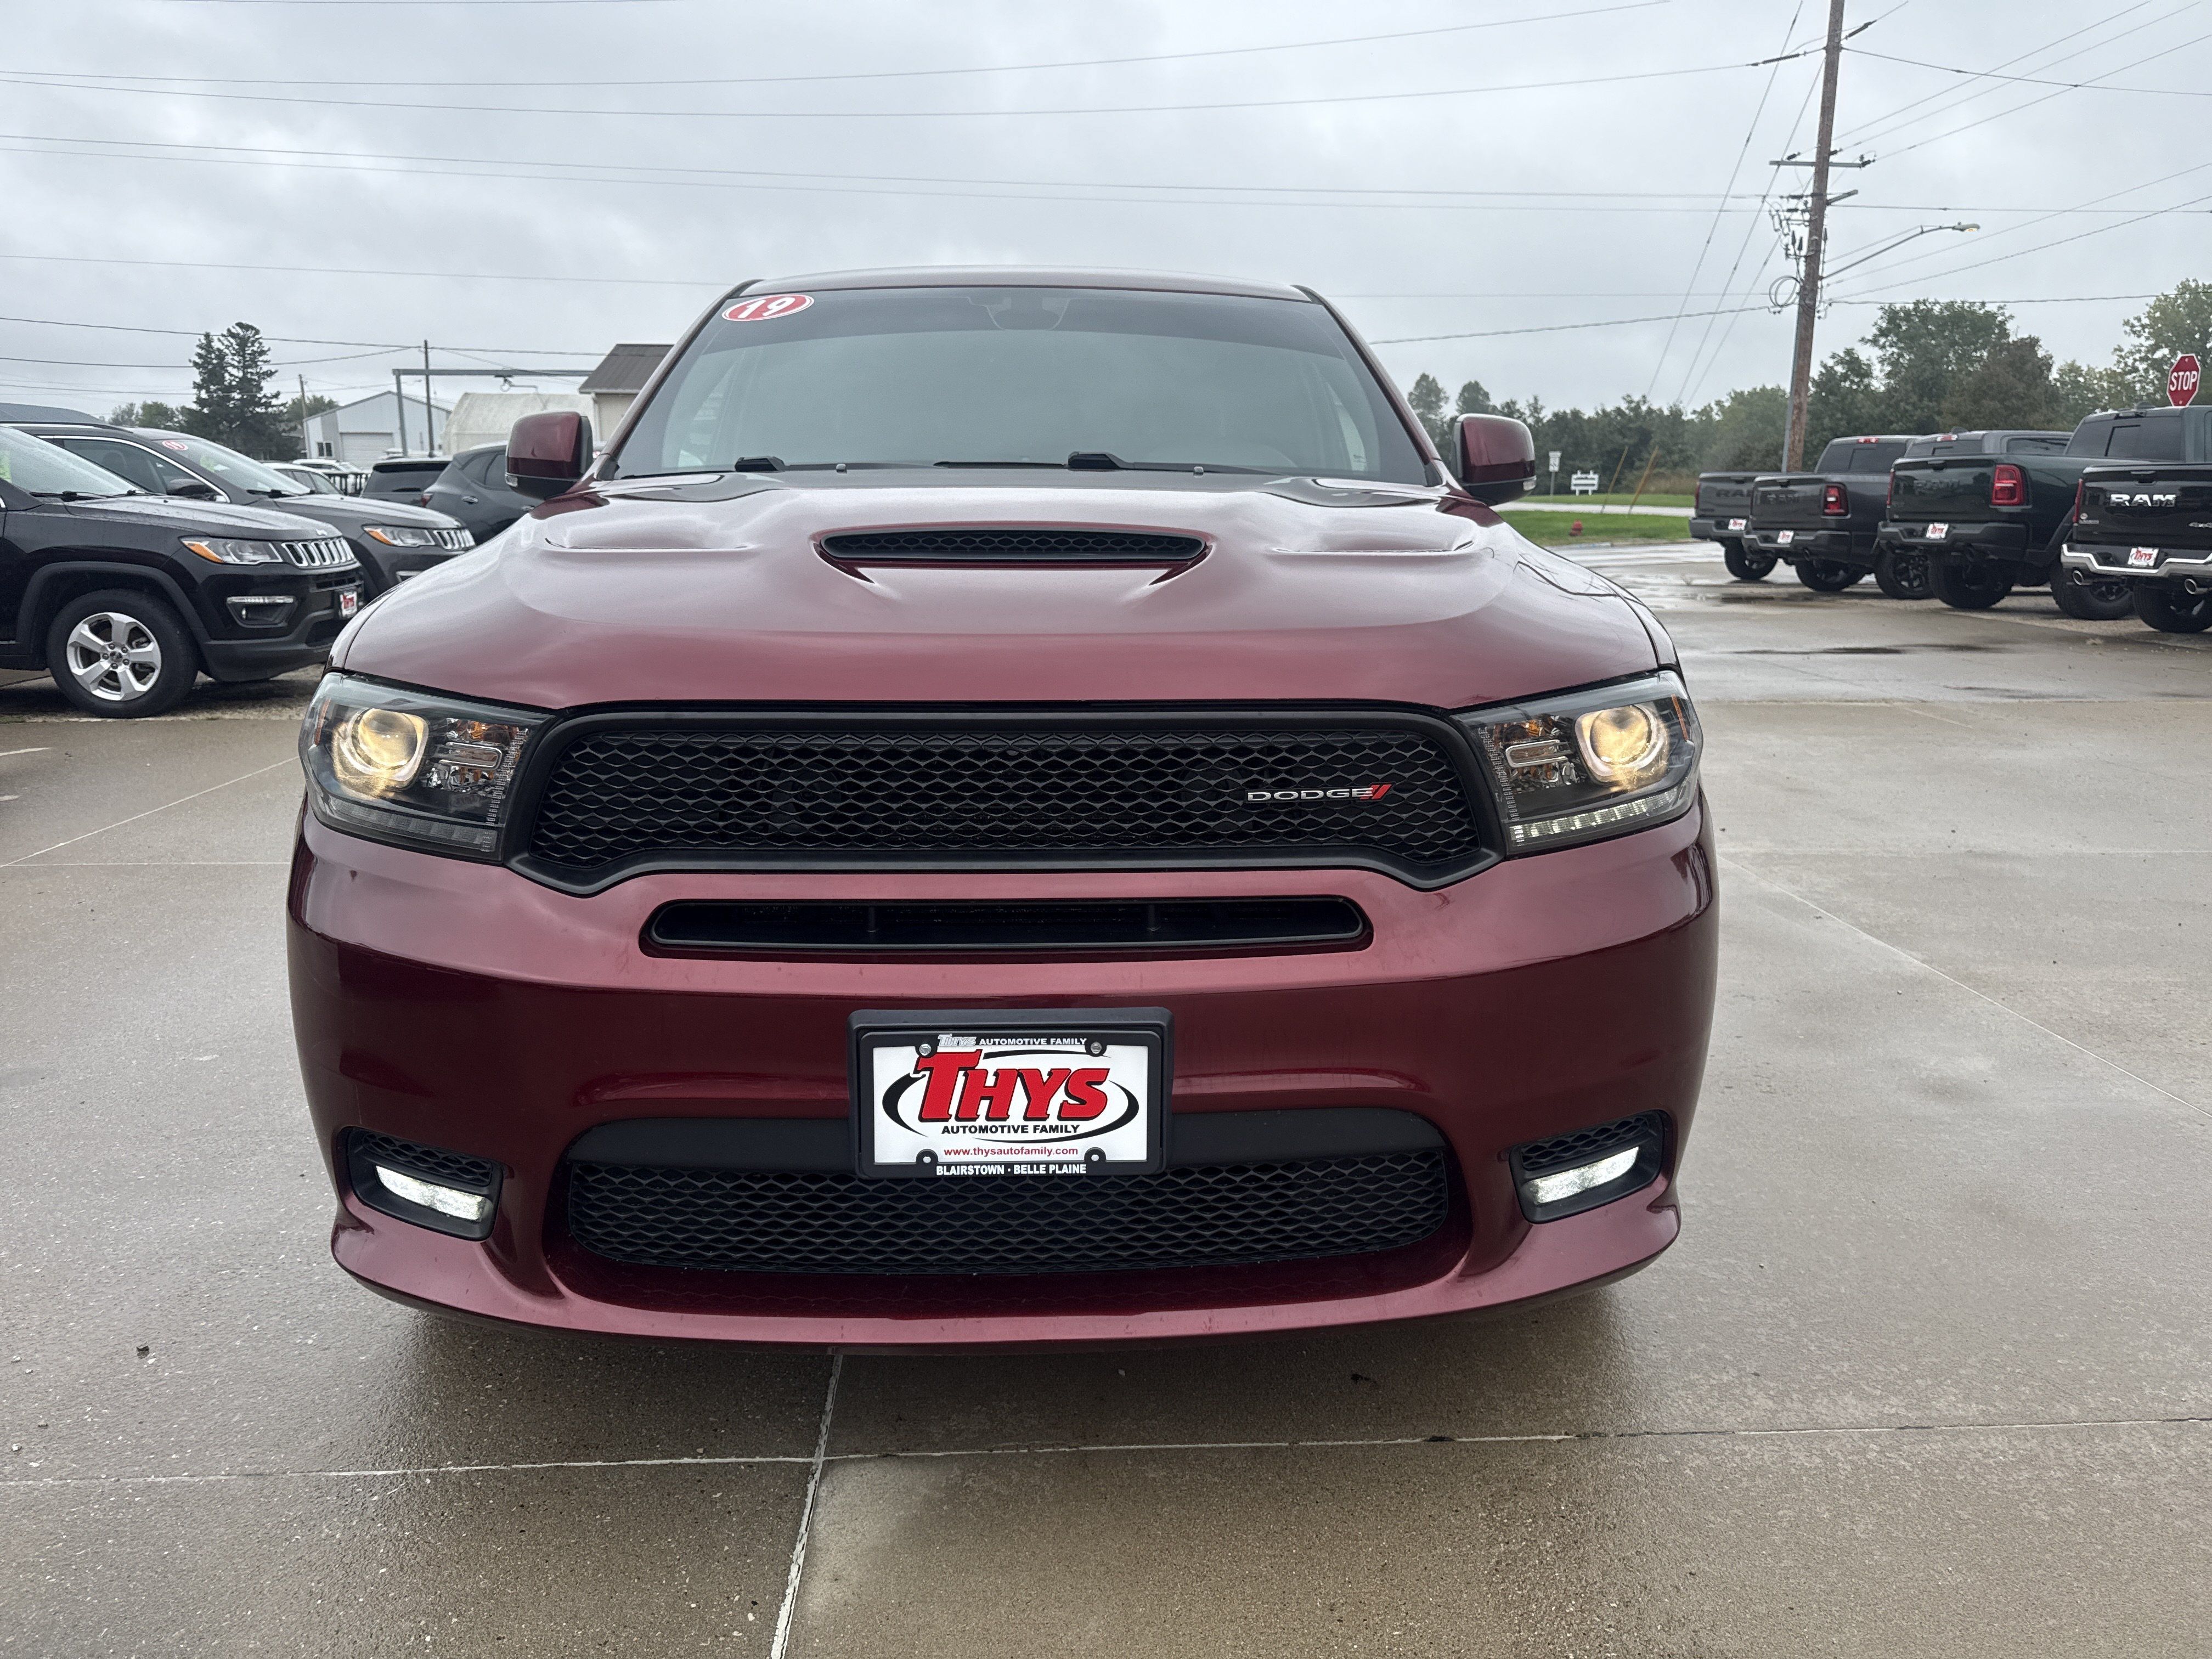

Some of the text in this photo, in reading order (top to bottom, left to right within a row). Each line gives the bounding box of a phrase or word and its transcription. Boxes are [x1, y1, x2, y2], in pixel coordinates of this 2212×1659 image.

[737, 297, 795, 319] 19
[2170, 370, 2198, 391] STOP
[2109, 494, 2176, 507] RAM
[1247, 787, 1374, 802] DODGE
[938, 1034, 977, 1046] THYS
[979, 1037, 1047, 1046] AUTOMOTIVE
[912, 1048, 1110, 1122] THYS
[941, 1124, 1080, 1134] AUTOMOTIVE FAMILY
[944, 1146, 1078, 1157] www.thysautofamily.com
[936, 1164, 1087, 1176] BLAIRSTOWN BELLE PLAINE
